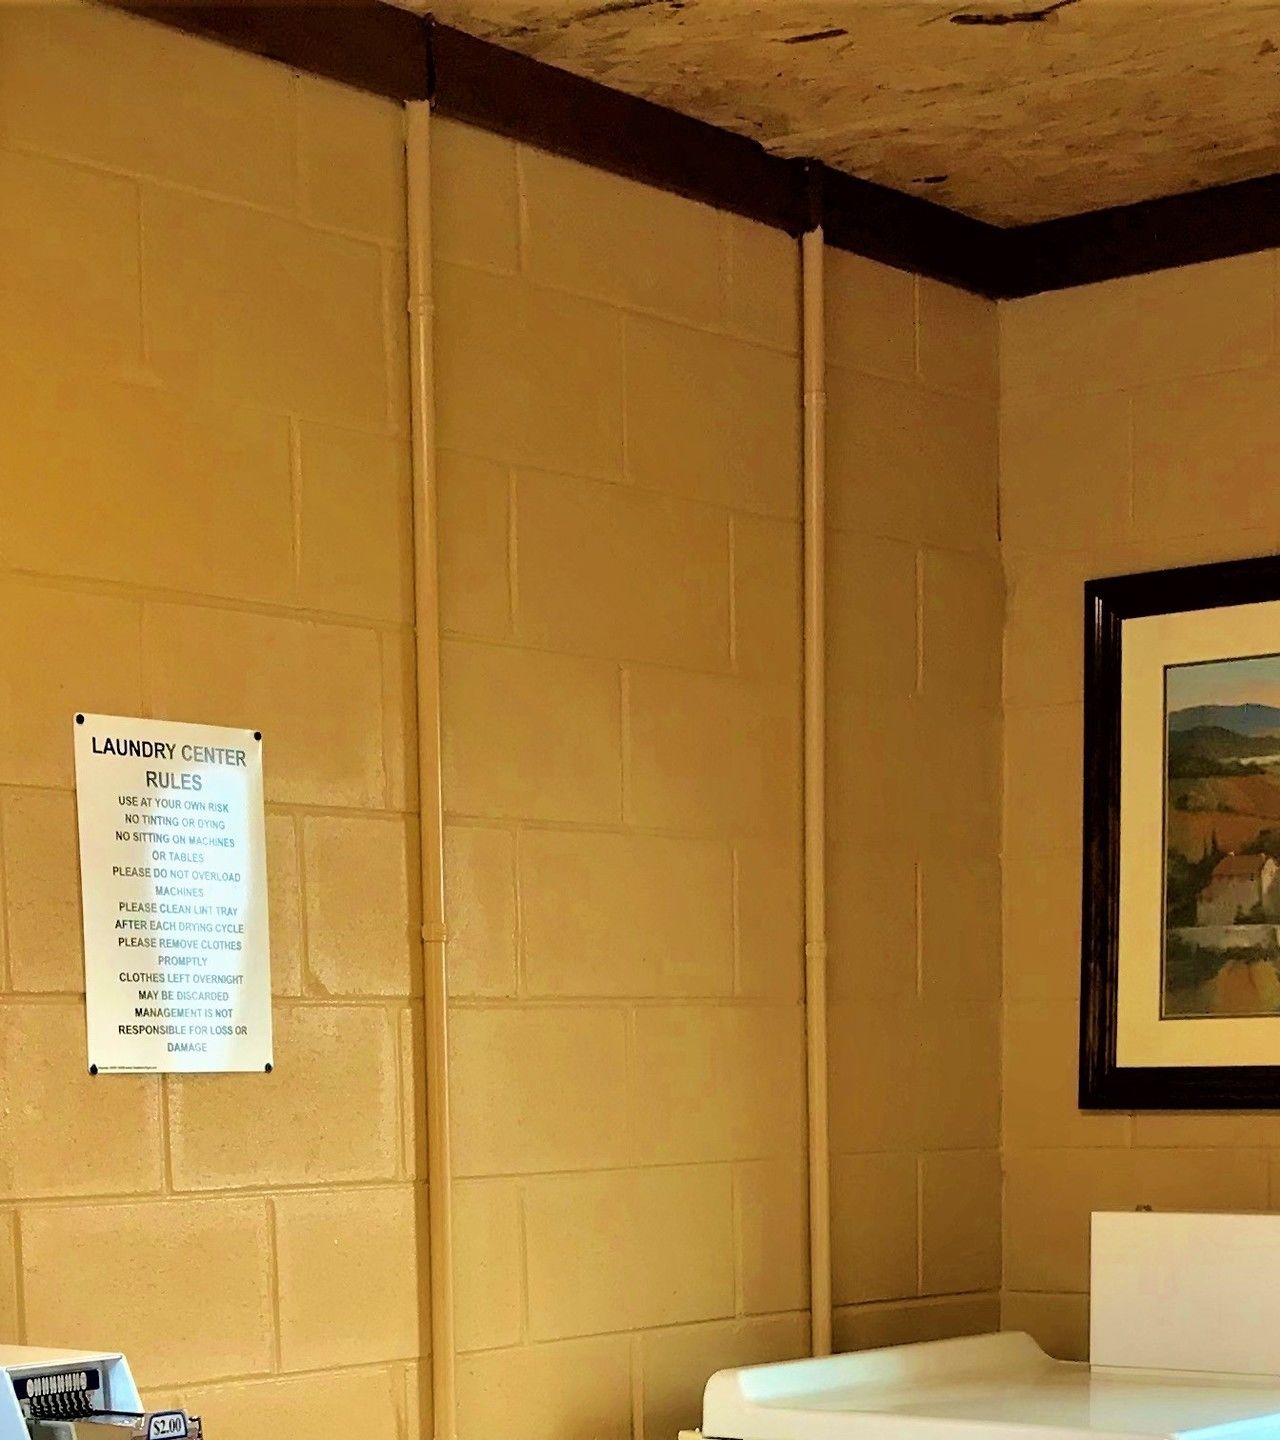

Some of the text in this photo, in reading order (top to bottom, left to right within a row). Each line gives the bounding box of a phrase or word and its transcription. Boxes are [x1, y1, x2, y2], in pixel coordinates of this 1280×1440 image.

[92, 737, 246, 766] LAUNDRY CENTER
[147, 771, 202, 790] RULES
[119, 796, 229, 812] USE AT YOUR OWN RISK
[125, 814, 225, 829] NO TINTING OR DYING
[116, 831, 234, 847] NO SITTING ON MACHINES
[152, 851, 204, 862] OR TABLES
[113, 866, 240, 881] PLEASE DO NOT OVERLOAD
[156, 886, 204, 896] MACHINES
[119, 902, 238, 916] PLEASE CLEAN LINT TRAY
[115, 920, 243, 933] AFTER EACH DRYING CYCLE
[119, 937, 241, 950] PLEASE REMOVE CLOTHES
[158, 956, 207, 966] PROMPTLY
[119, 973, 243, 984] CLOTHES LEFT OVERNIGHT
[139, 991, 228, 1001] MAY BE DISCARDED
[135, 1008, 233, 1018] MANAGEMENT IS NOT
[119, 1025, 247, 1035] RESPONSIBLE FOR LOSS OR
[167, 1043, 207, 1052] DAMAGE
[154, 1418, 181, 1436] $2.00
